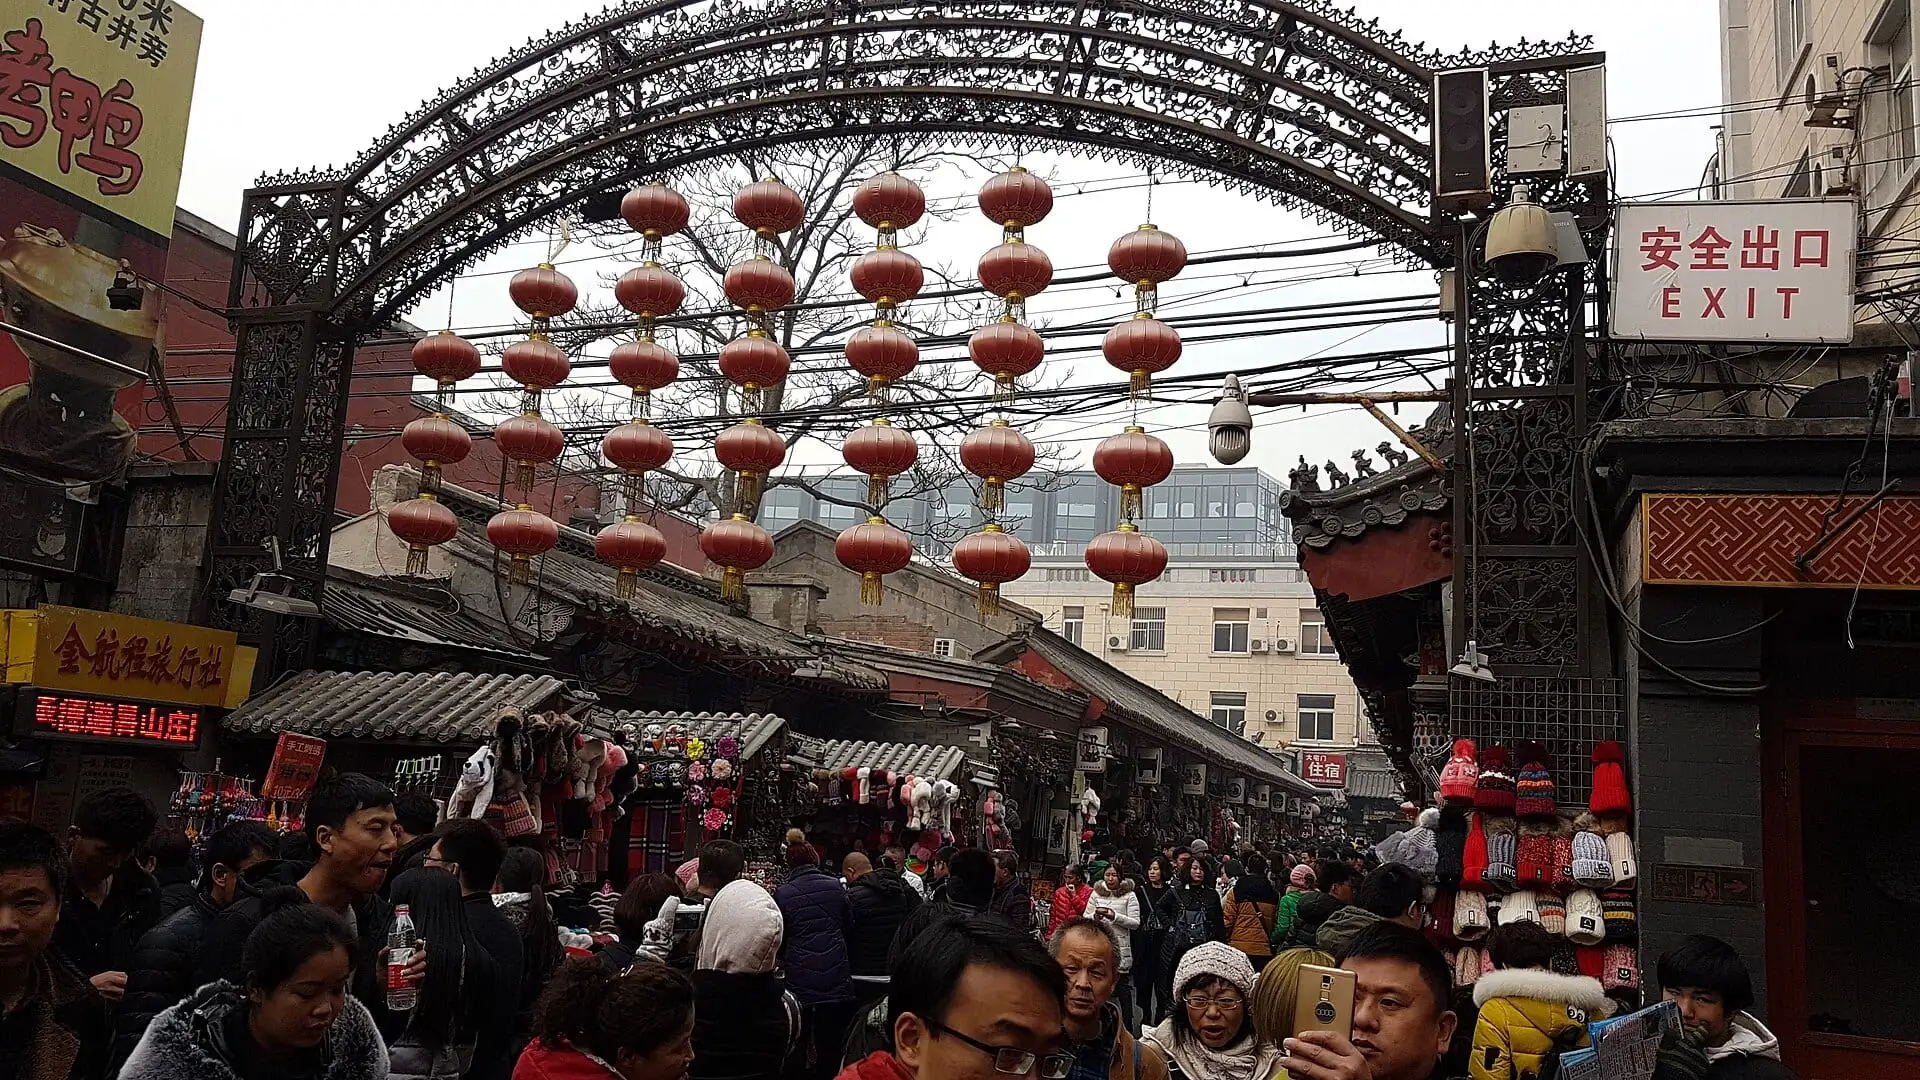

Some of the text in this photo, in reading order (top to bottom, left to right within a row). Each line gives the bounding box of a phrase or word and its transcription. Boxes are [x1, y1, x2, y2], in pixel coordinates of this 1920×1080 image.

[1639, 225, 1829, 272] 安全出口
[1661, 287, 1800, 319] EXIT
[1308, 761, 1341, 778] 住宿
